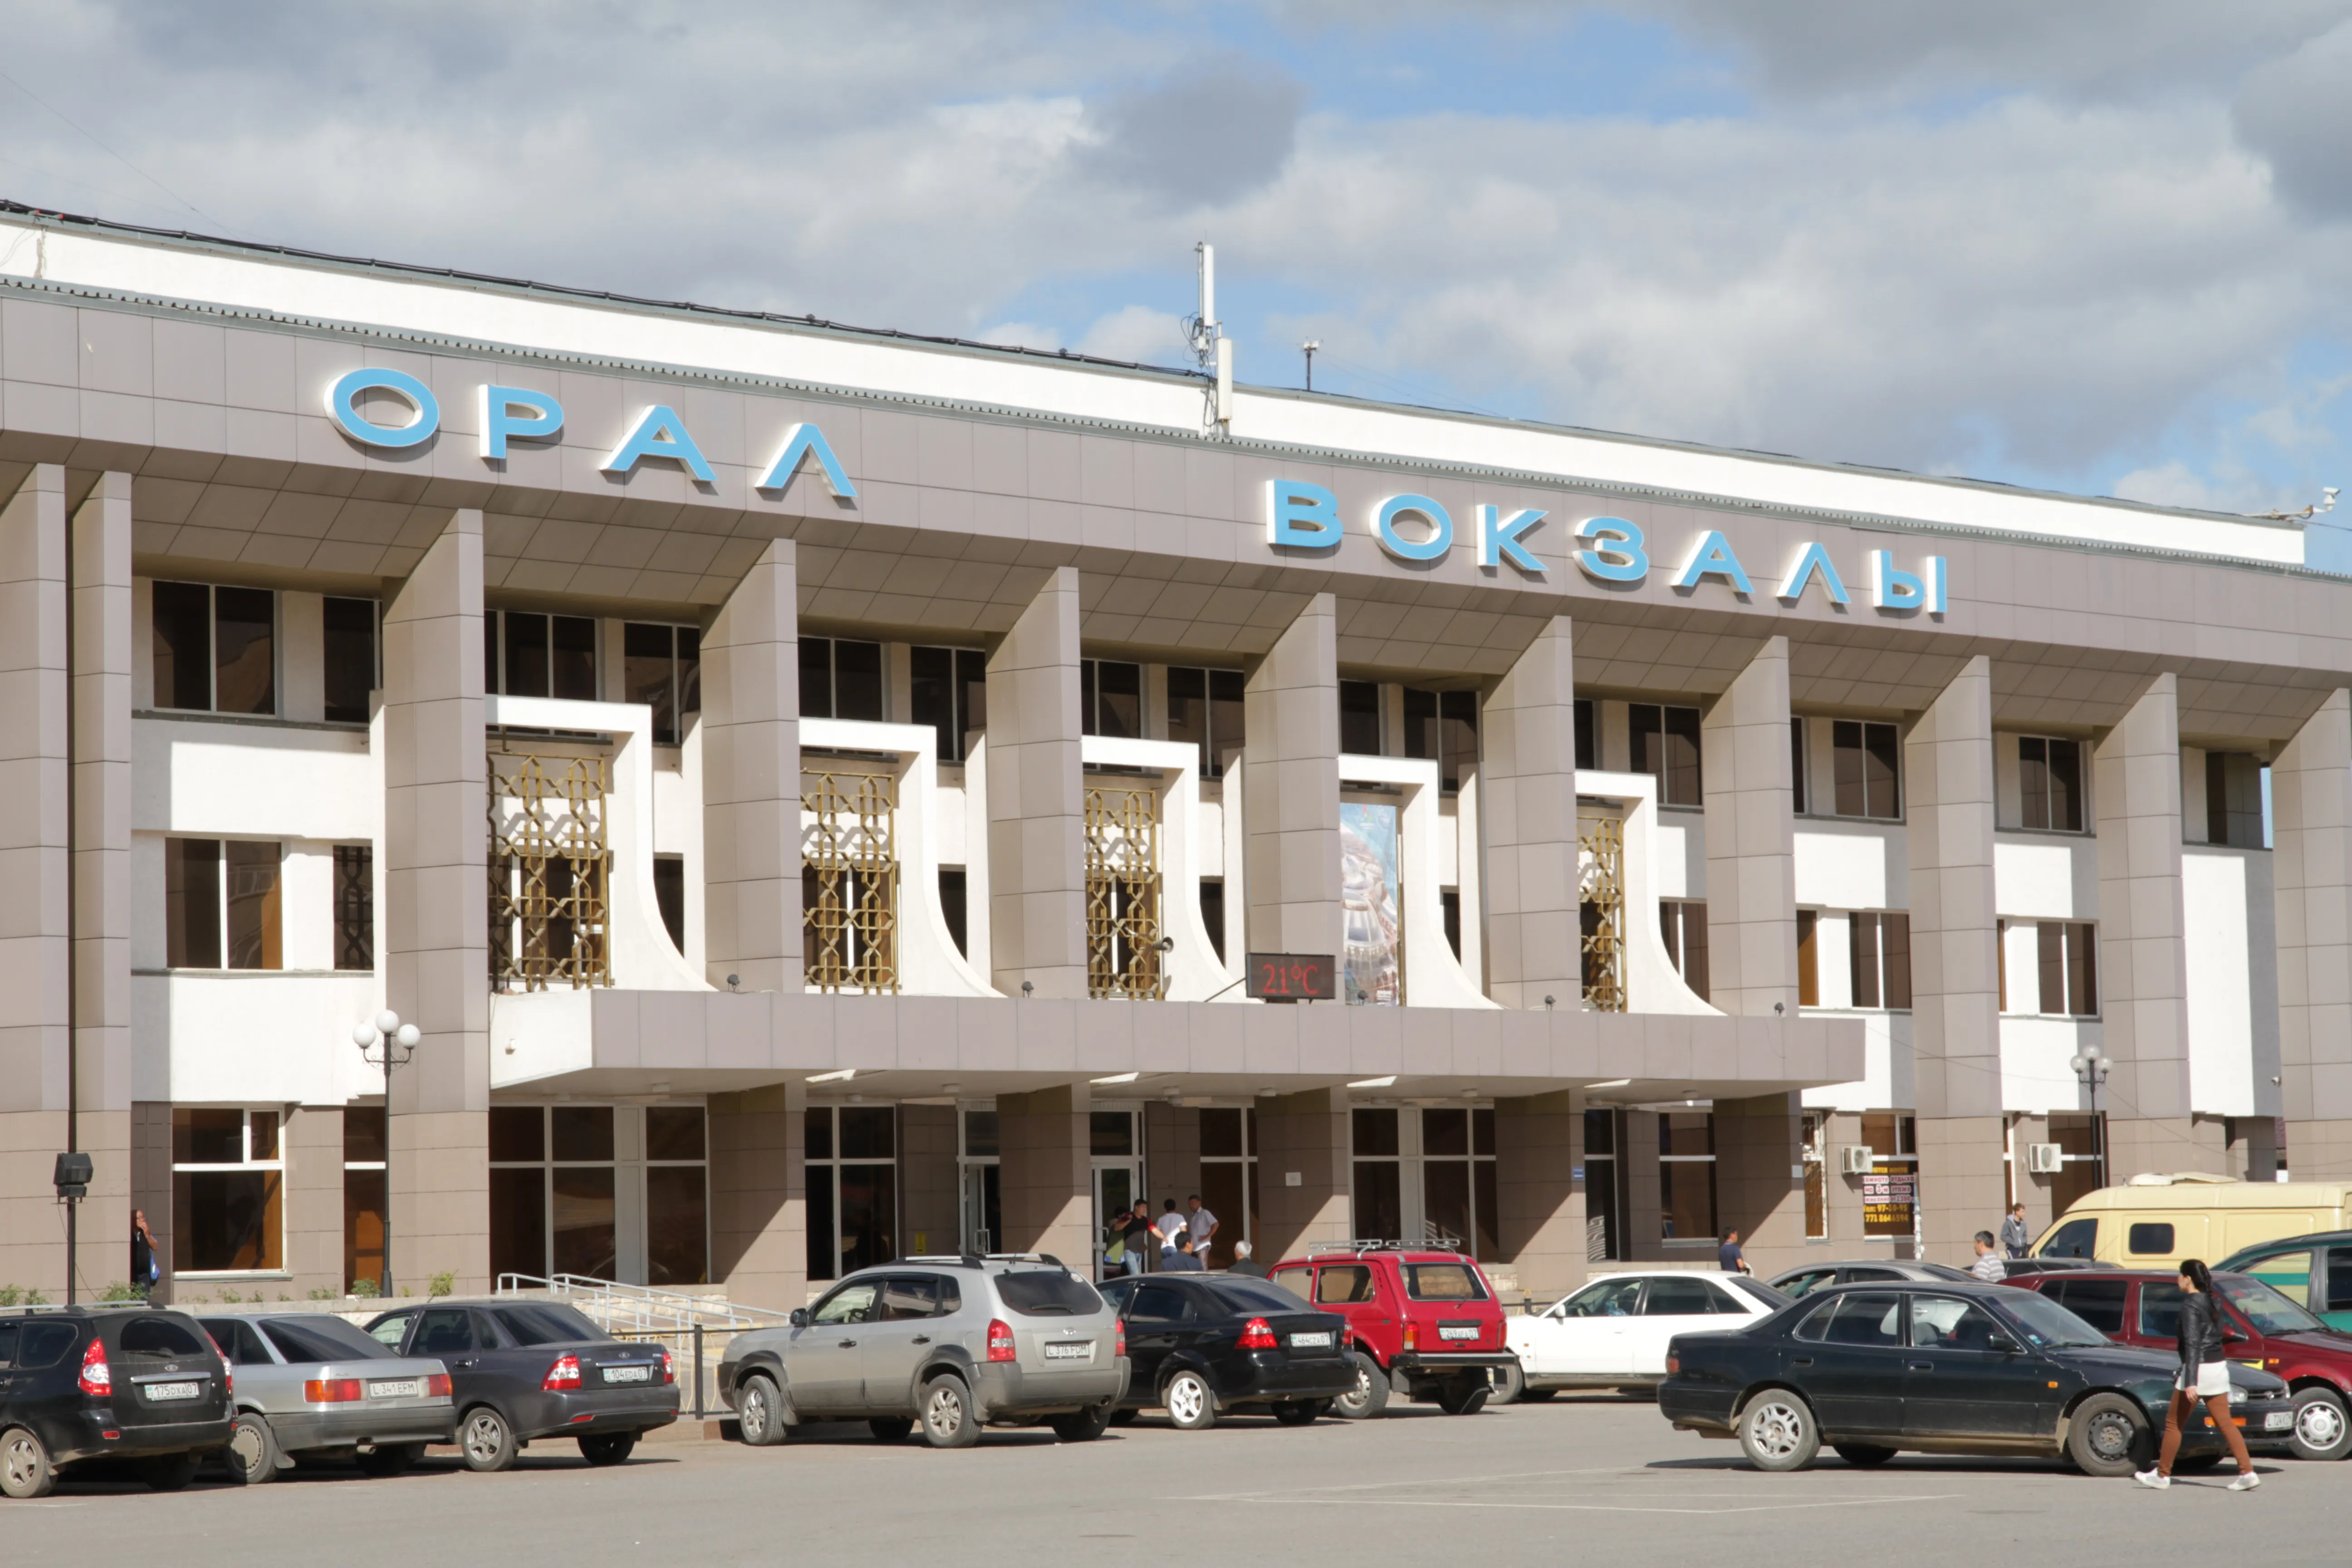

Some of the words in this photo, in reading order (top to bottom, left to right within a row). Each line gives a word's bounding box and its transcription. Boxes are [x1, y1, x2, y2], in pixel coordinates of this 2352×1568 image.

[323, 367, 858, 498] ОРАЛ
[1265, 478, 1947, 614] ВОКЗАЛЫ
[1263, 964, 1319, 995] 21°C
